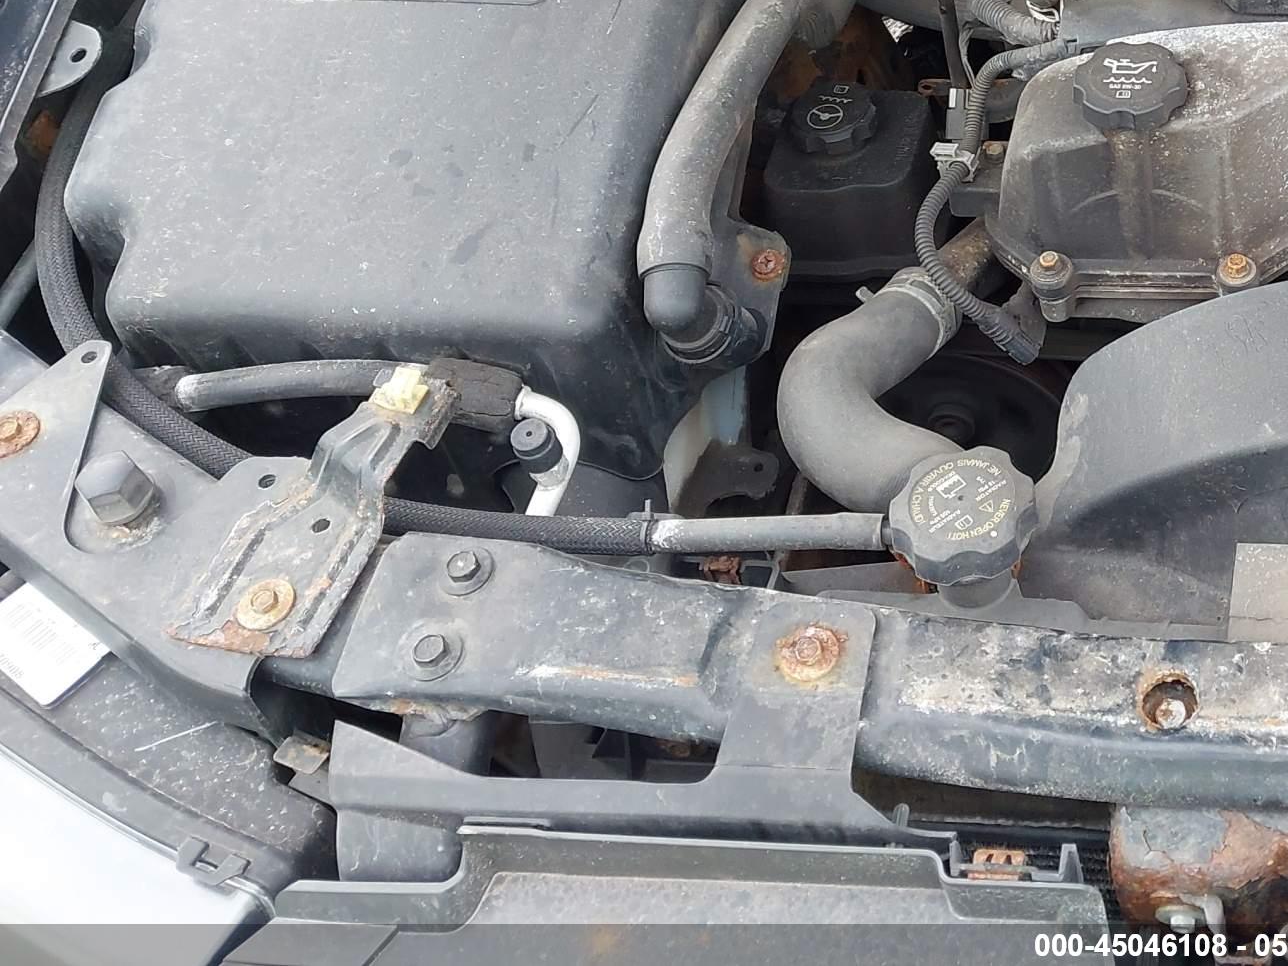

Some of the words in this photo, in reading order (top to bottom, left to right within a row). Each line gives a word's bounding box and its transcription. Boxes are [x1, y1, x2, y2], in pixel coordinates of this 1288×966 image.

[923, 462, 954, 487] OUVRIR
[957, 459, 990, 469] JAMAIS
[975, 479, 1007, 502] RADIATOR
[929, 509, 961, 533] RADIATEUR
[993, 498, 1011, 523] NEVER
[969, 521, 994, 536] OPEN
